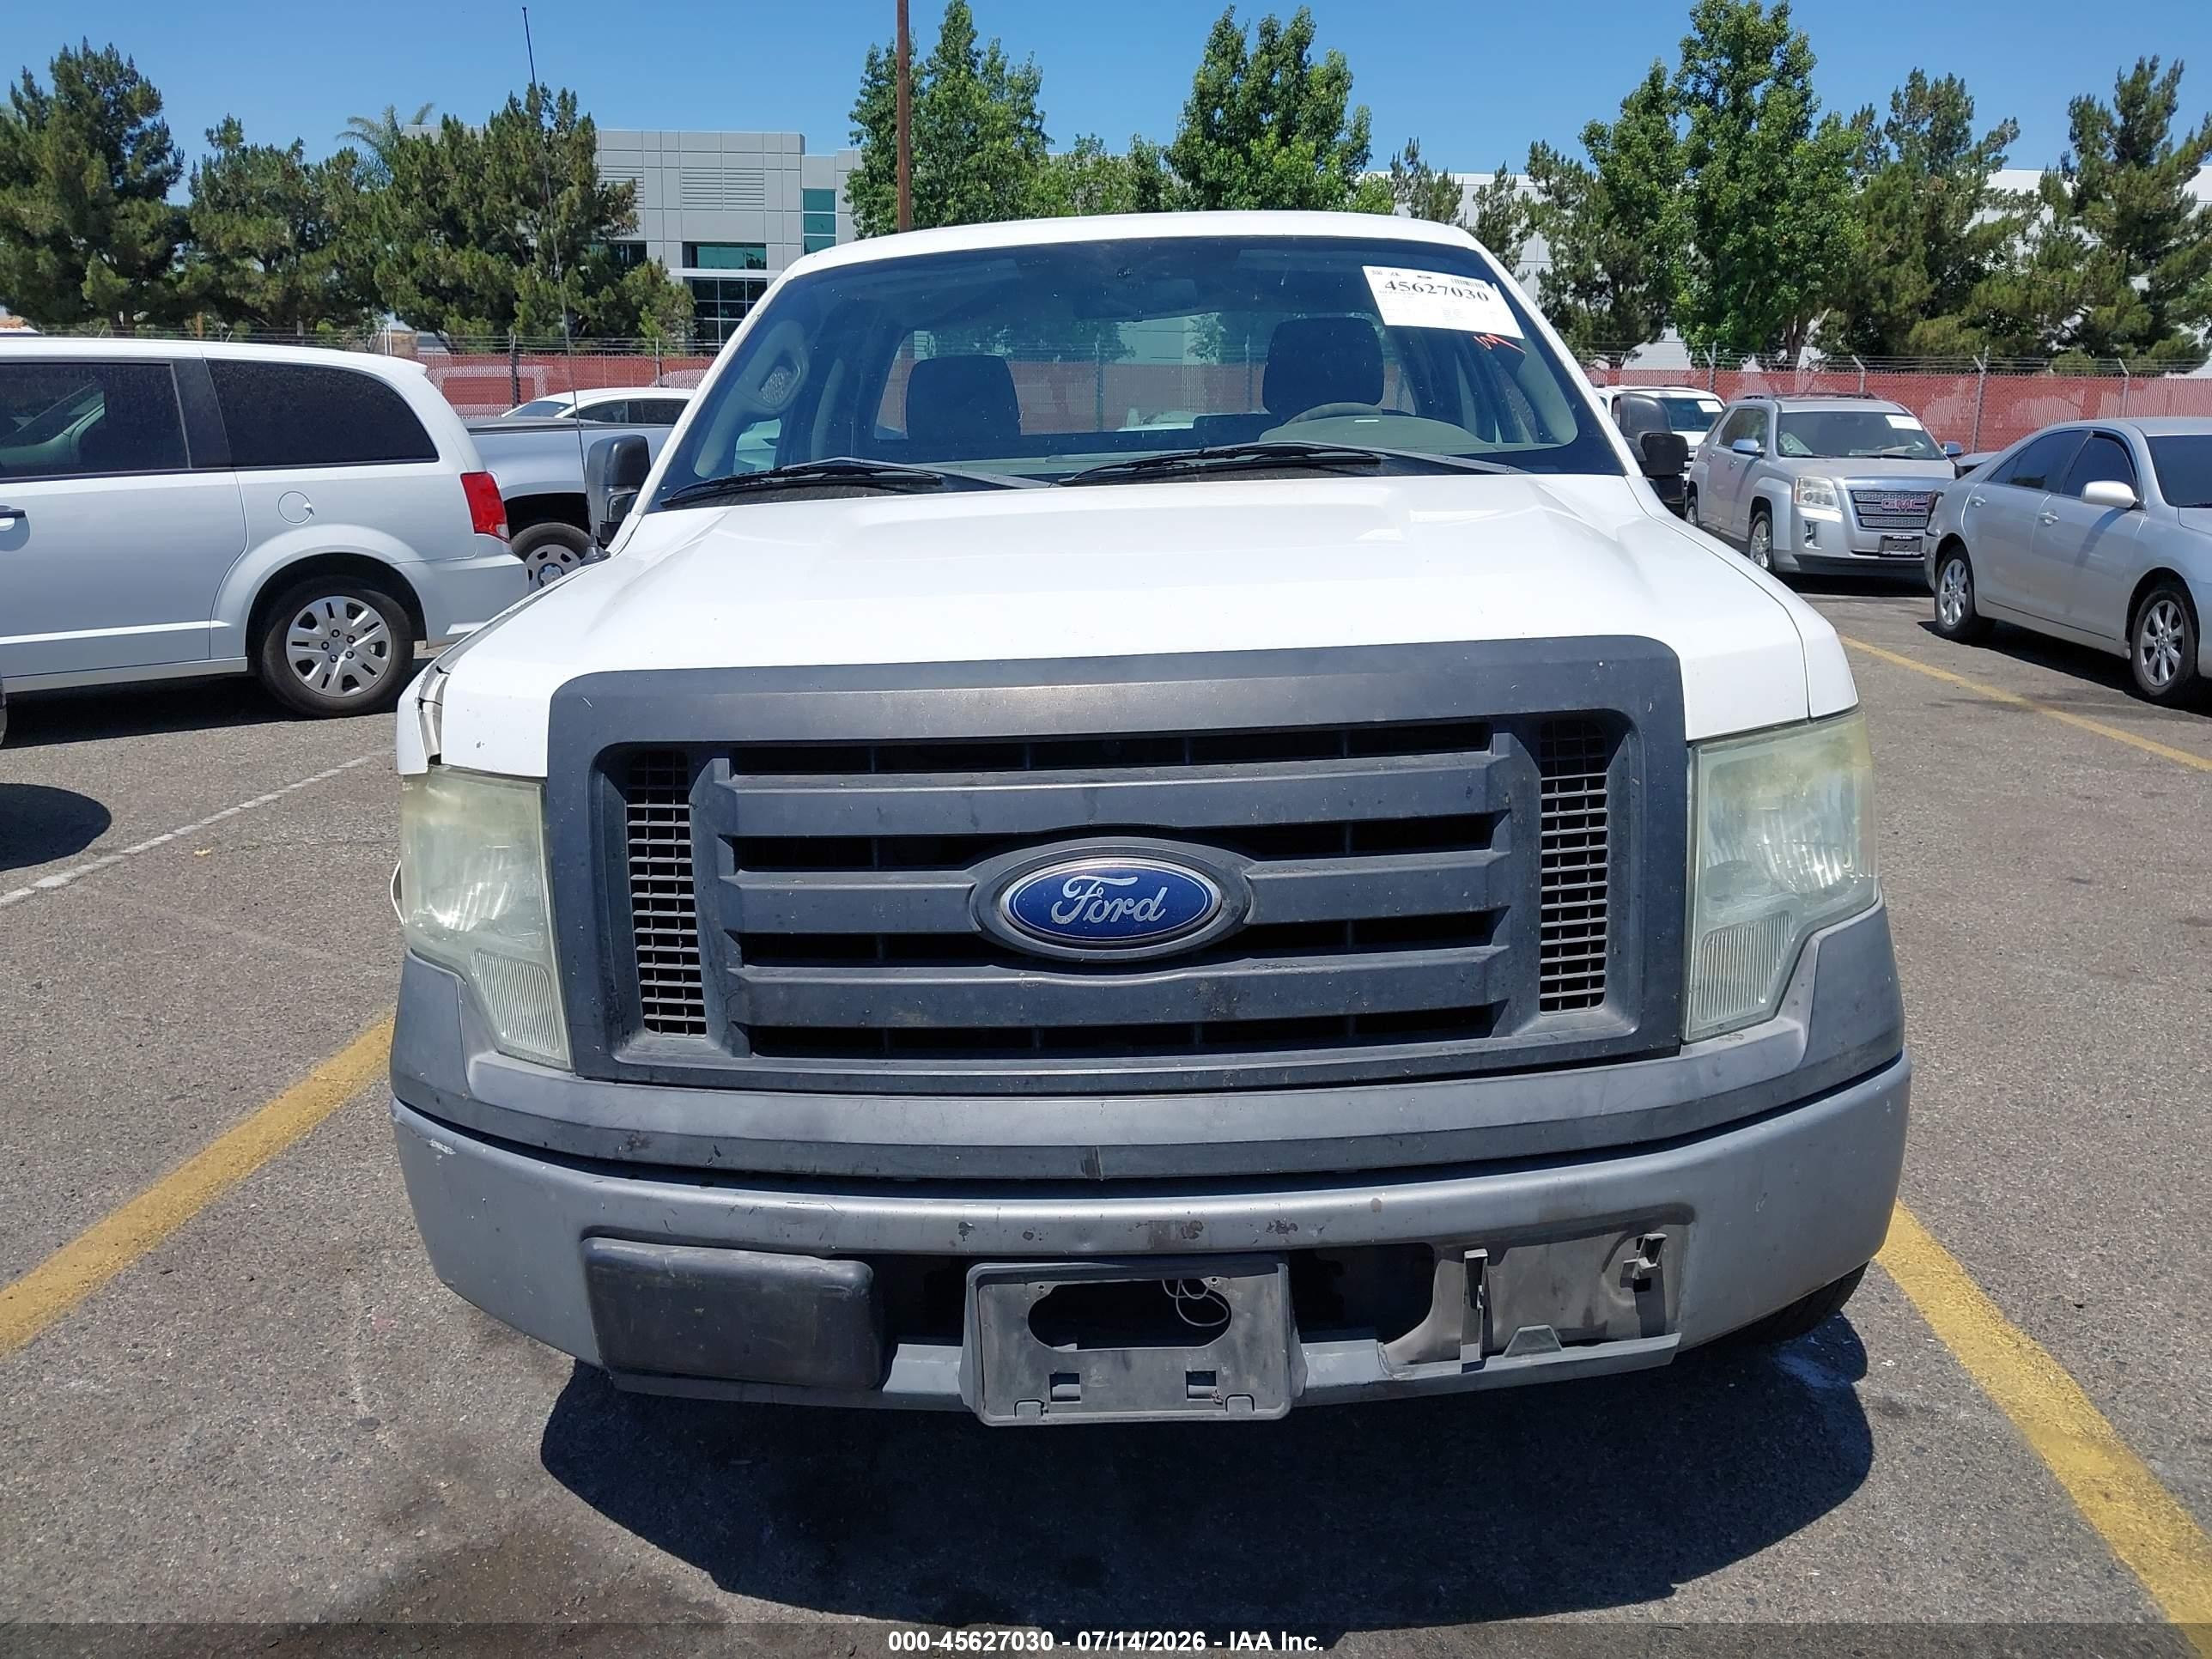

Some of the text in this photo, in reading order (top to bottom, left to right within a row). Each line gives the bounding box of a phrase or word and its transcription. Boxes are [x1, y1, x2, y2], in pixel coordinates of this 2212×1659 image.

[1384, 280, 1490, 301] 45627030
[1881, 499, 1929, 509] GMC
[1050, 875, 1168, 924] Ford
